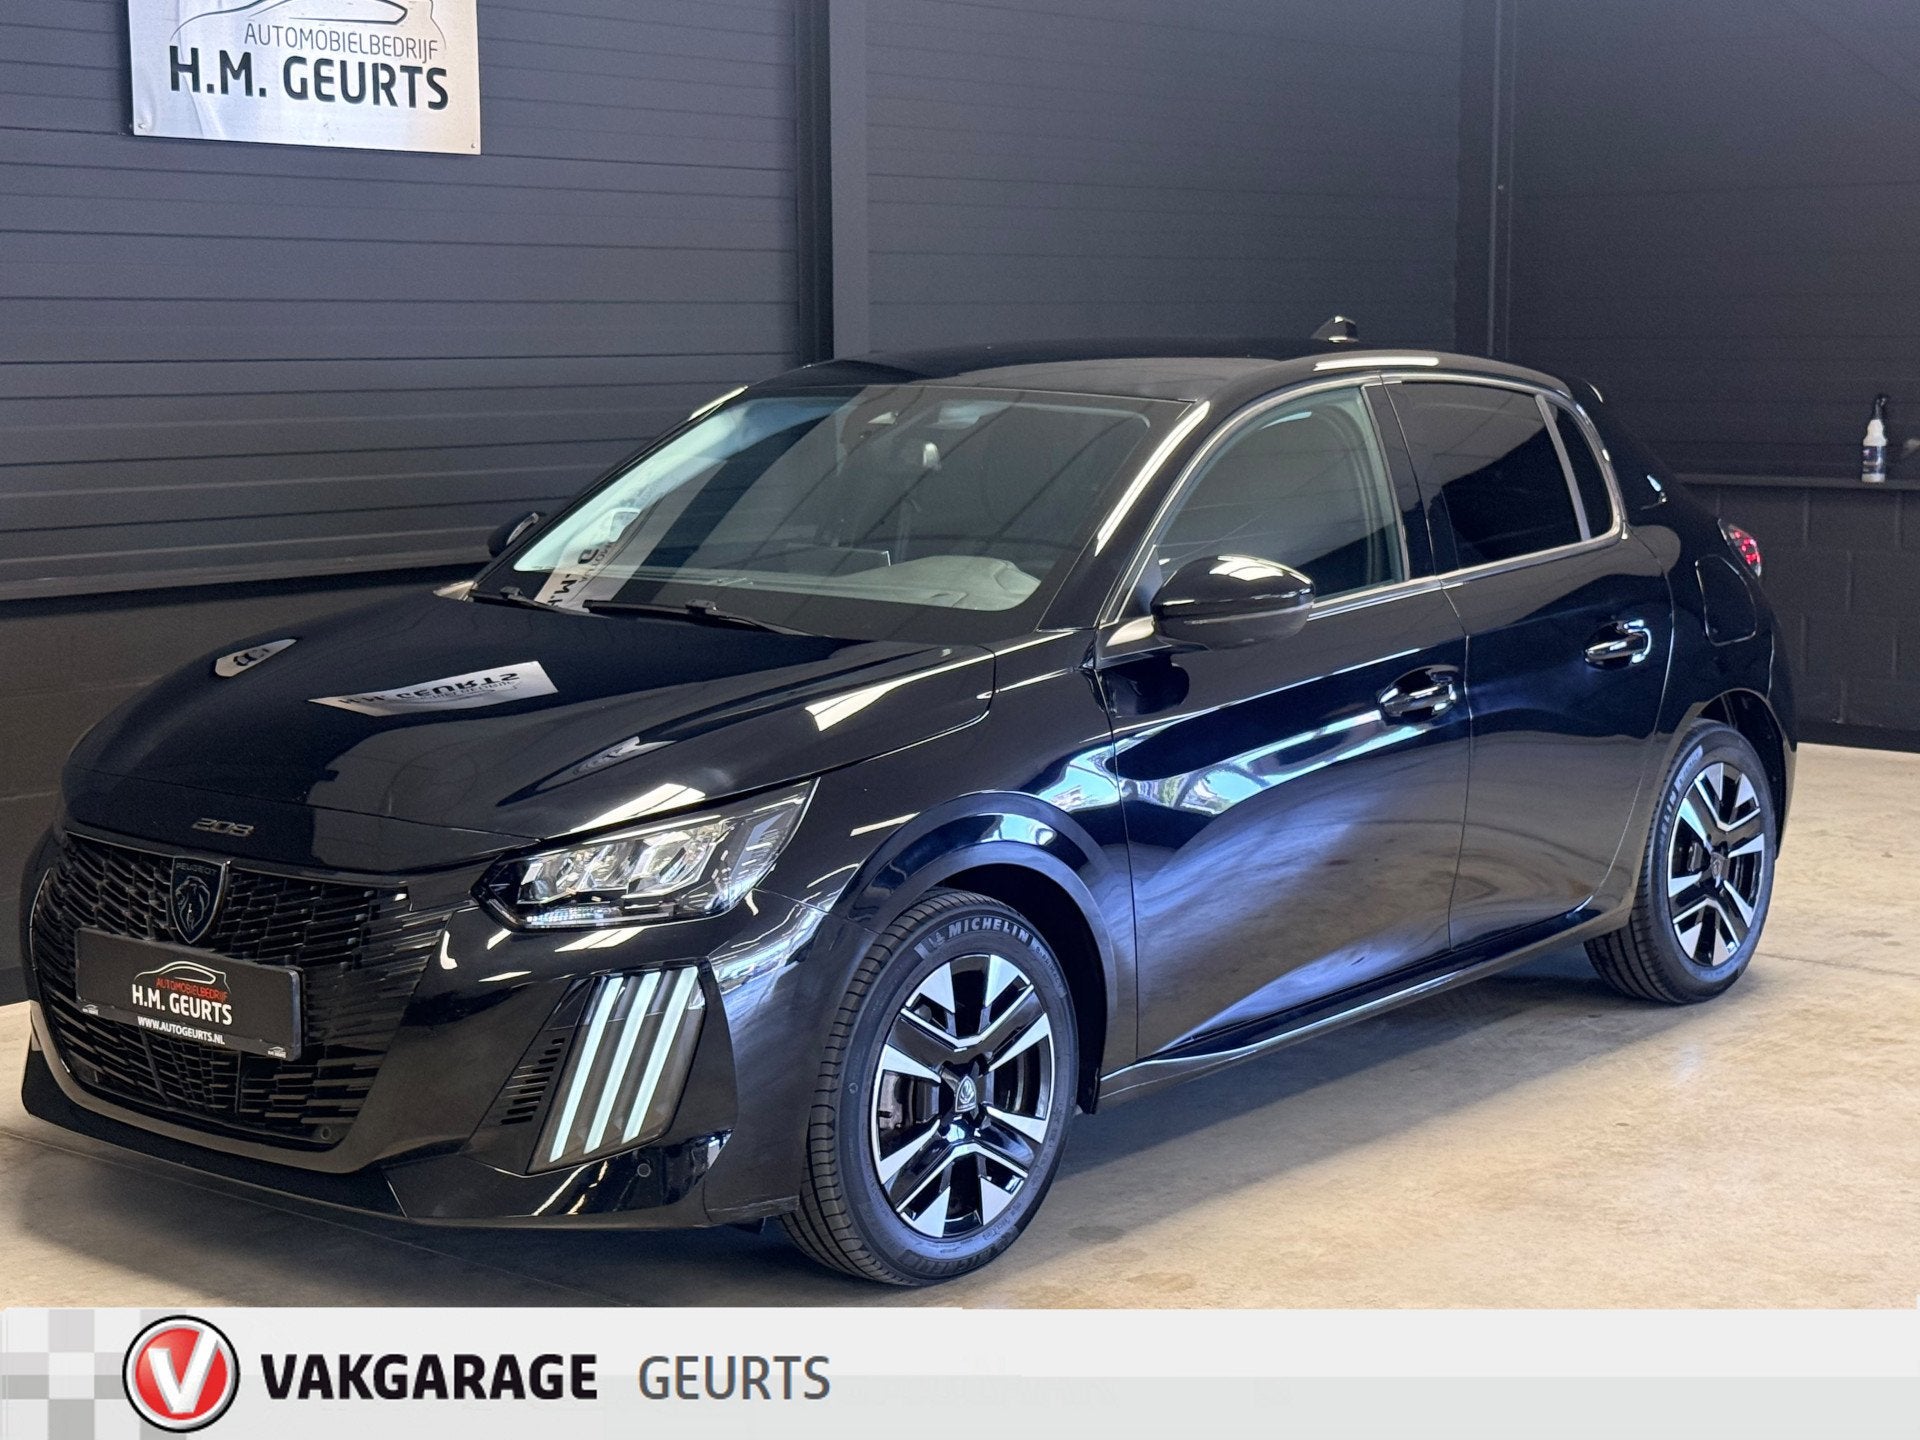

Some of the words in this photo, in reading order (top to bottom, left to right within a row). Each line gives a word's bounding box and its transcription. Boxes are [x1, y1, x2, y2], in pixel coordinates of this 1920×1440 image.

[244, 22, 438, 64] AUTOMOBIELBEDRIJF
[169, 45, 267, 98] H.M.
[283, 56, 449, 110] GEURTS
[192, 818, 255, 838] 208
[175, 862, 219, 876] PEUGEOT
[949, 917, 1029, 943] MICHELIN
[155, 977, 229, 1003] AUTOMOBIELBEDRIJF
[131, 984, 166, 1011] H.M.
[169, 992, 233, 1026] GEURTS
[137, 1015, 226, 1046] WWW.AUTOGEURTS.NL
